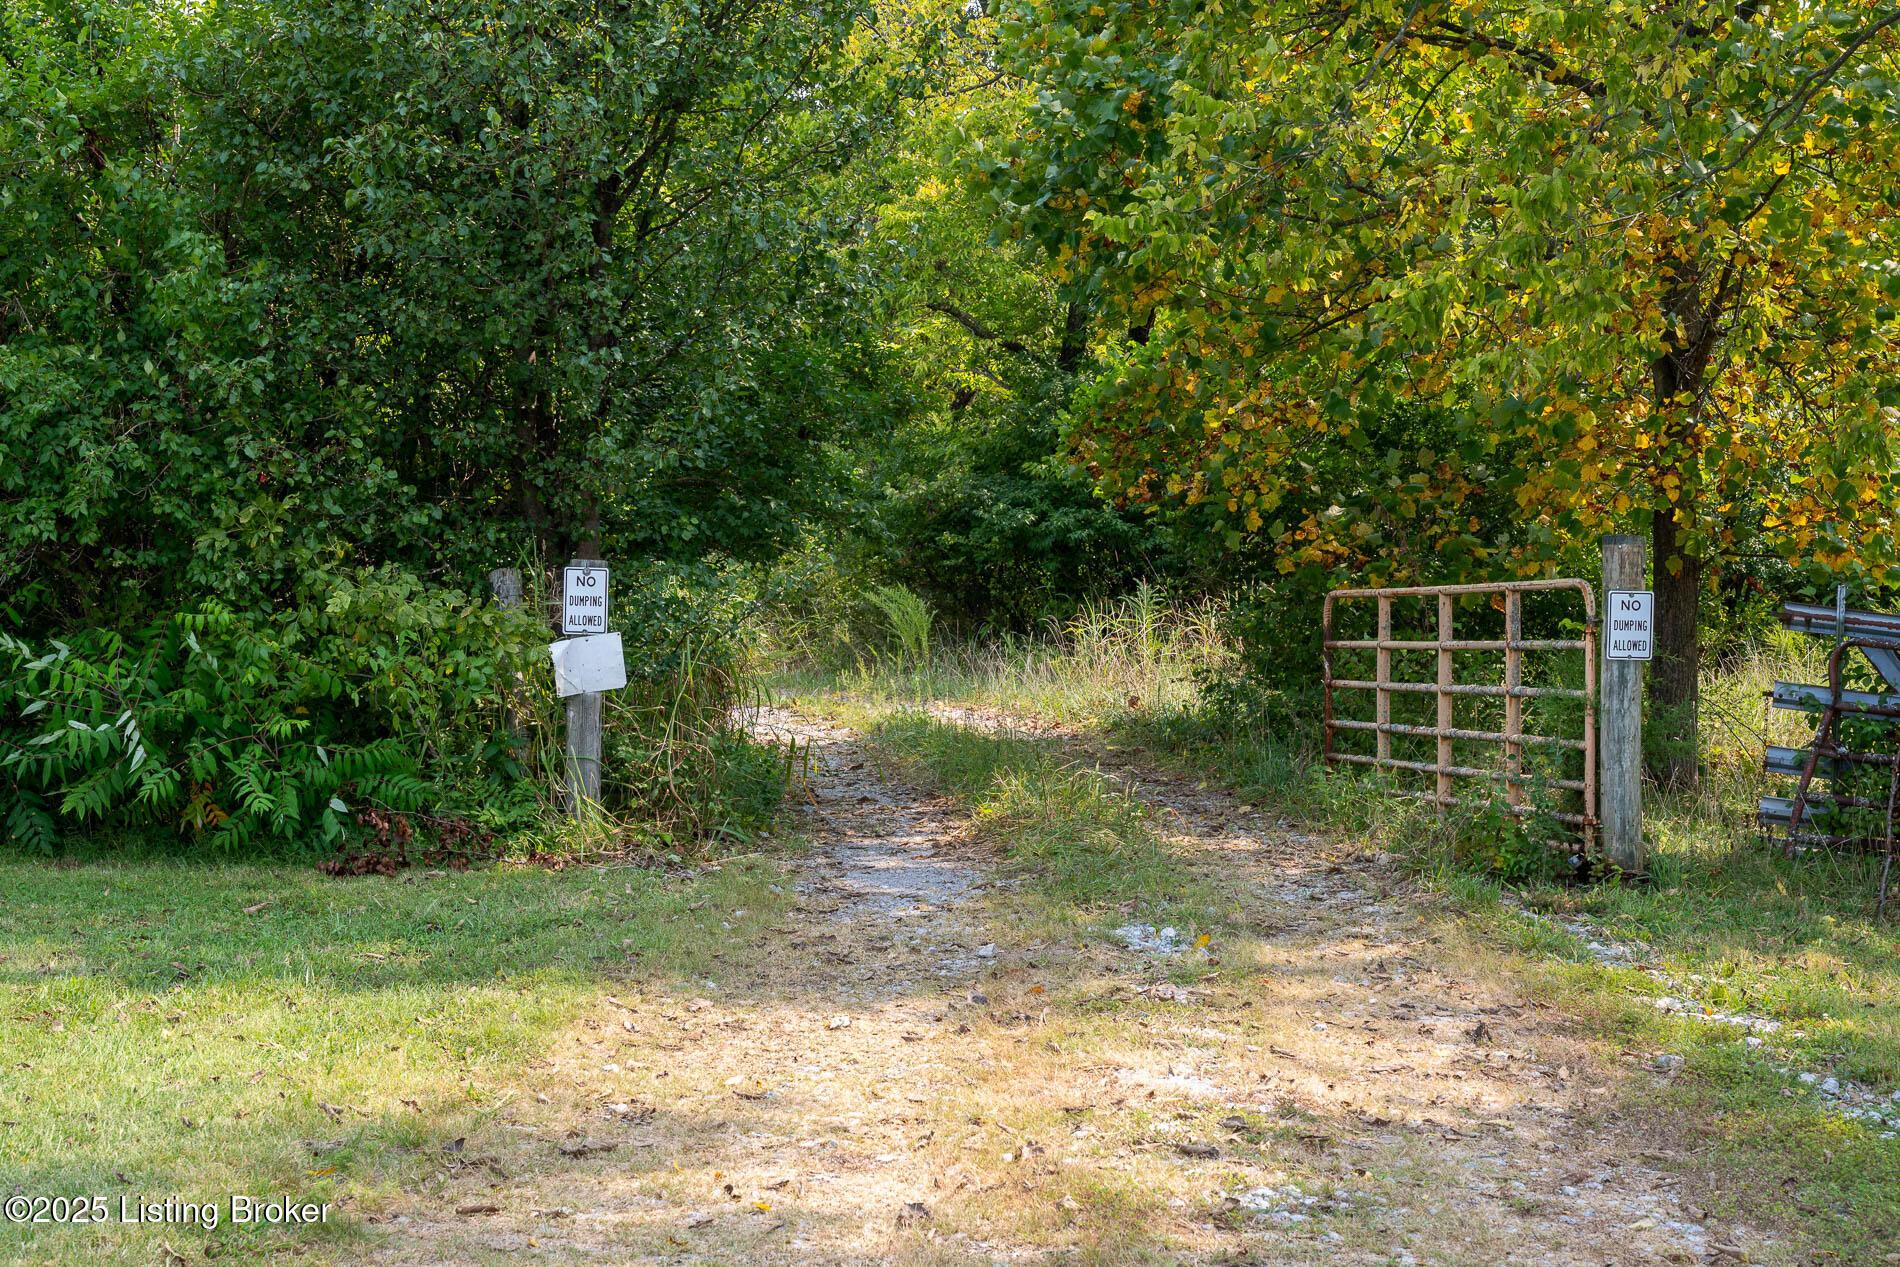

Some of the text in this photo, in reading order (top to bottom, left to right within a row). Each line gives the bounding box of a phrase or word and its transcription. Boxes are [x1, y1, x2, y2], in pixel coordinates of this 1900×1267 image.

[576, 576, 596, 587] NO
[569, 595, 602, 607] DUMPING
[1621, 600, 1641, 611] NO
[568, 615, 602, 627] ALLOWED
[1613, 620, 1648, 631] DUMPING
[1613, 640, 1647, 651] ALLOWED
